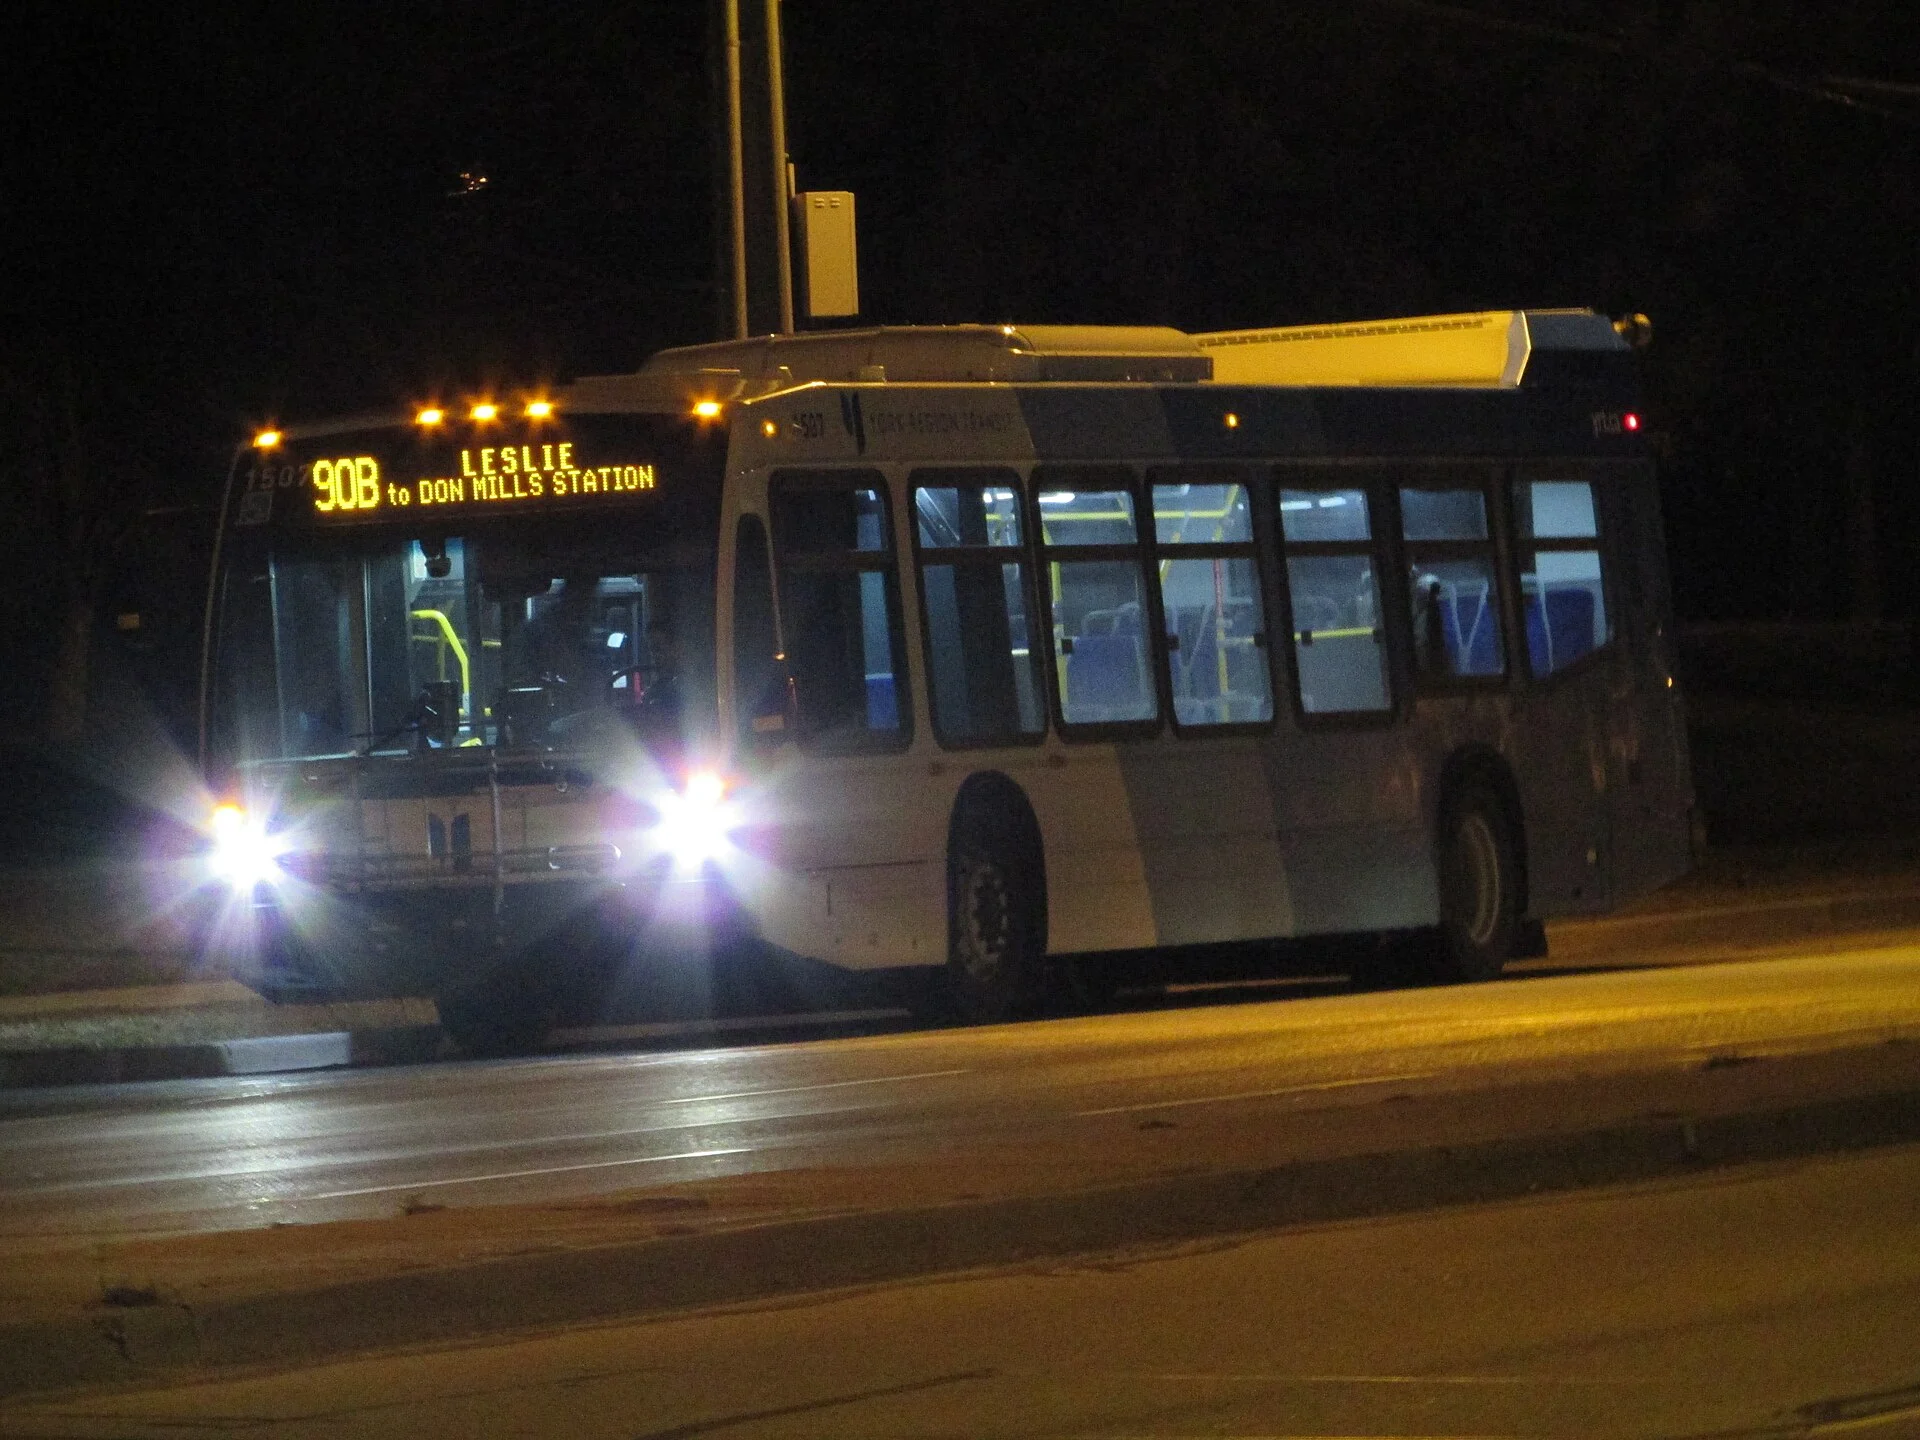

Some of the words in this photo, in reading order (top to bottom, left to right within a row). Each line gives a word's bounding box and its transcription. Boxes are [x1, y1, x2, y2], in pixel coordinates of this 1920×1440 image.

[245, 464, 310, 491] 1507
[461, 442, 574, 477] LESLIE
[312, 456, 380, 512] 90B
[387, 482, 410, 506] to
[419, 470, 464, 504] DON
[472, 472, 544, 501] MILLS
[552, 465, 654, 495] STATION
